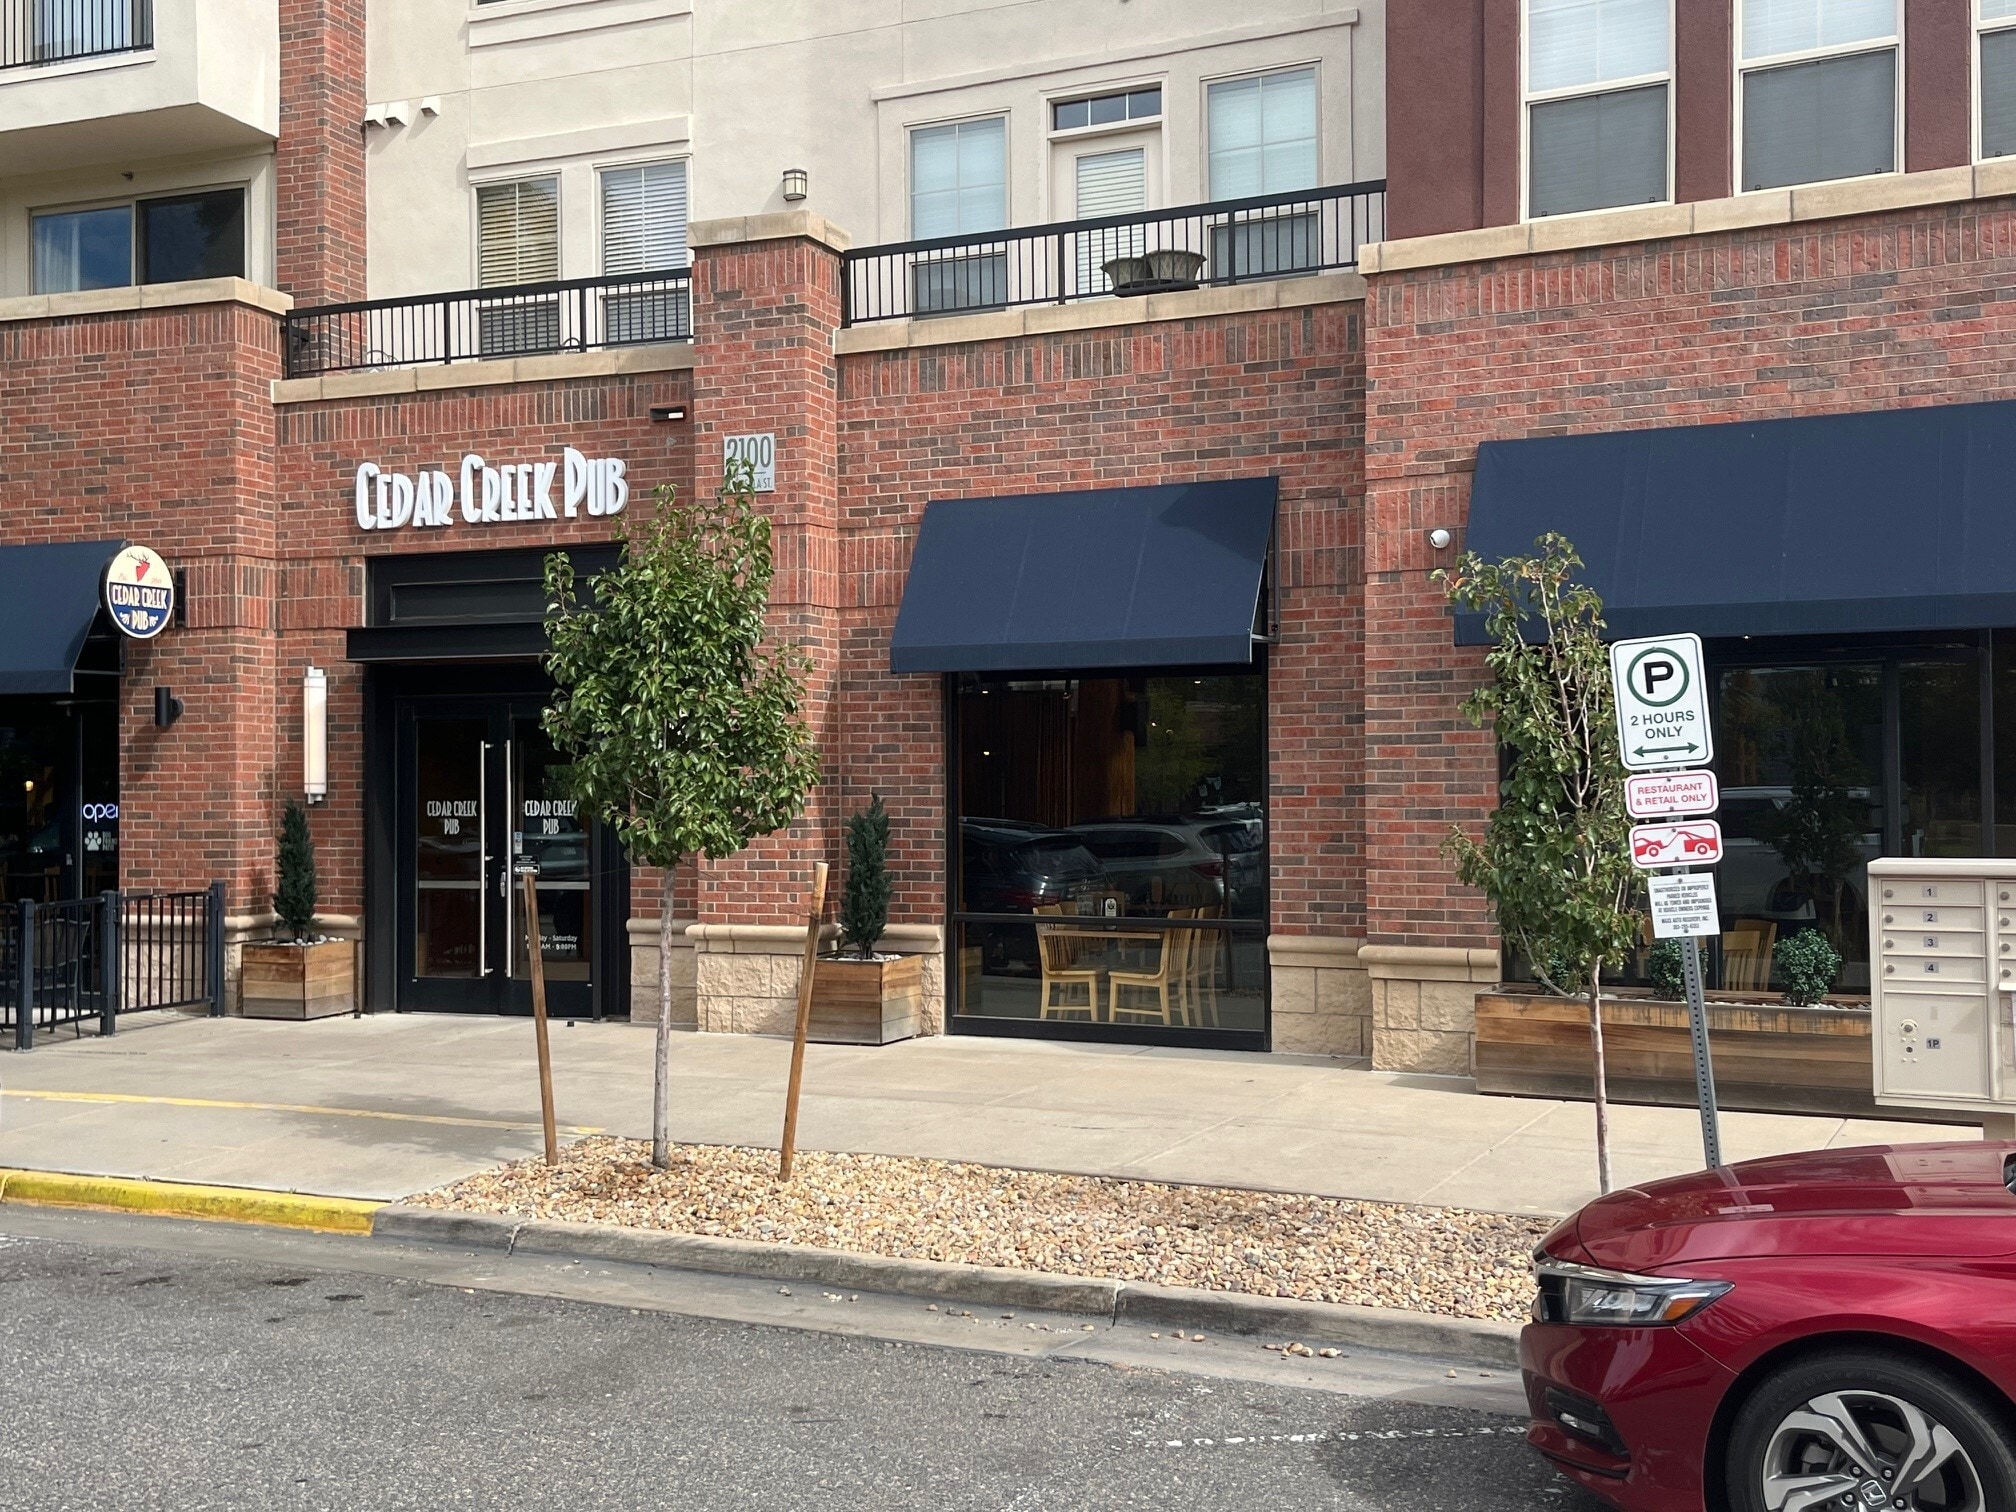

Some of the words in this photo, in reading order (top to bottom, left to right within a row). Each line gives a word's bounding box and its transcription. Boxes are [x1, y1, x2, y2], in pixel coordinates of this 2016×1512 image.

[727, 436, 771, 470] 2100
[356, 462, 454, 530] CEDAR
[461, 453, 558, 524] CREEK
[564, 447, 629, 518] PUB
[112, 584, 140, 607] CEDAR
[141, 588, 168, 609] CREEK
[132, 610, 149, 630] PUB
[1643, 660, 1674, 694] P
[1630, 715, 1639, 726] 2
[1642, 710, 1695, 725] HOURS
[1645, 726, 1682, 739] ONLY
[1637, 782, 1702, 794] RESTAURANT
[1636, 798, 1642, 806] &
[1645, 796, 1678, 805] RETAIL
[1681, 793, 1707, 802] ONLY
[427, 800, 452, 816] CEDAR
[453, 800, 477, 816] CREEK
[524, 800, 551, 816] CEDAR
[444, 818, 460, 835] PUB
[543, 818, 560, 835] PUB
[1926, 888, 1932, 896] 1
[1927, 913, 1933, 921] 2
[553, 934, 577, 942] Saturday
[1927, 939, 1934, 947] 3
[1927, 1039, 1940, 1048] 1P
